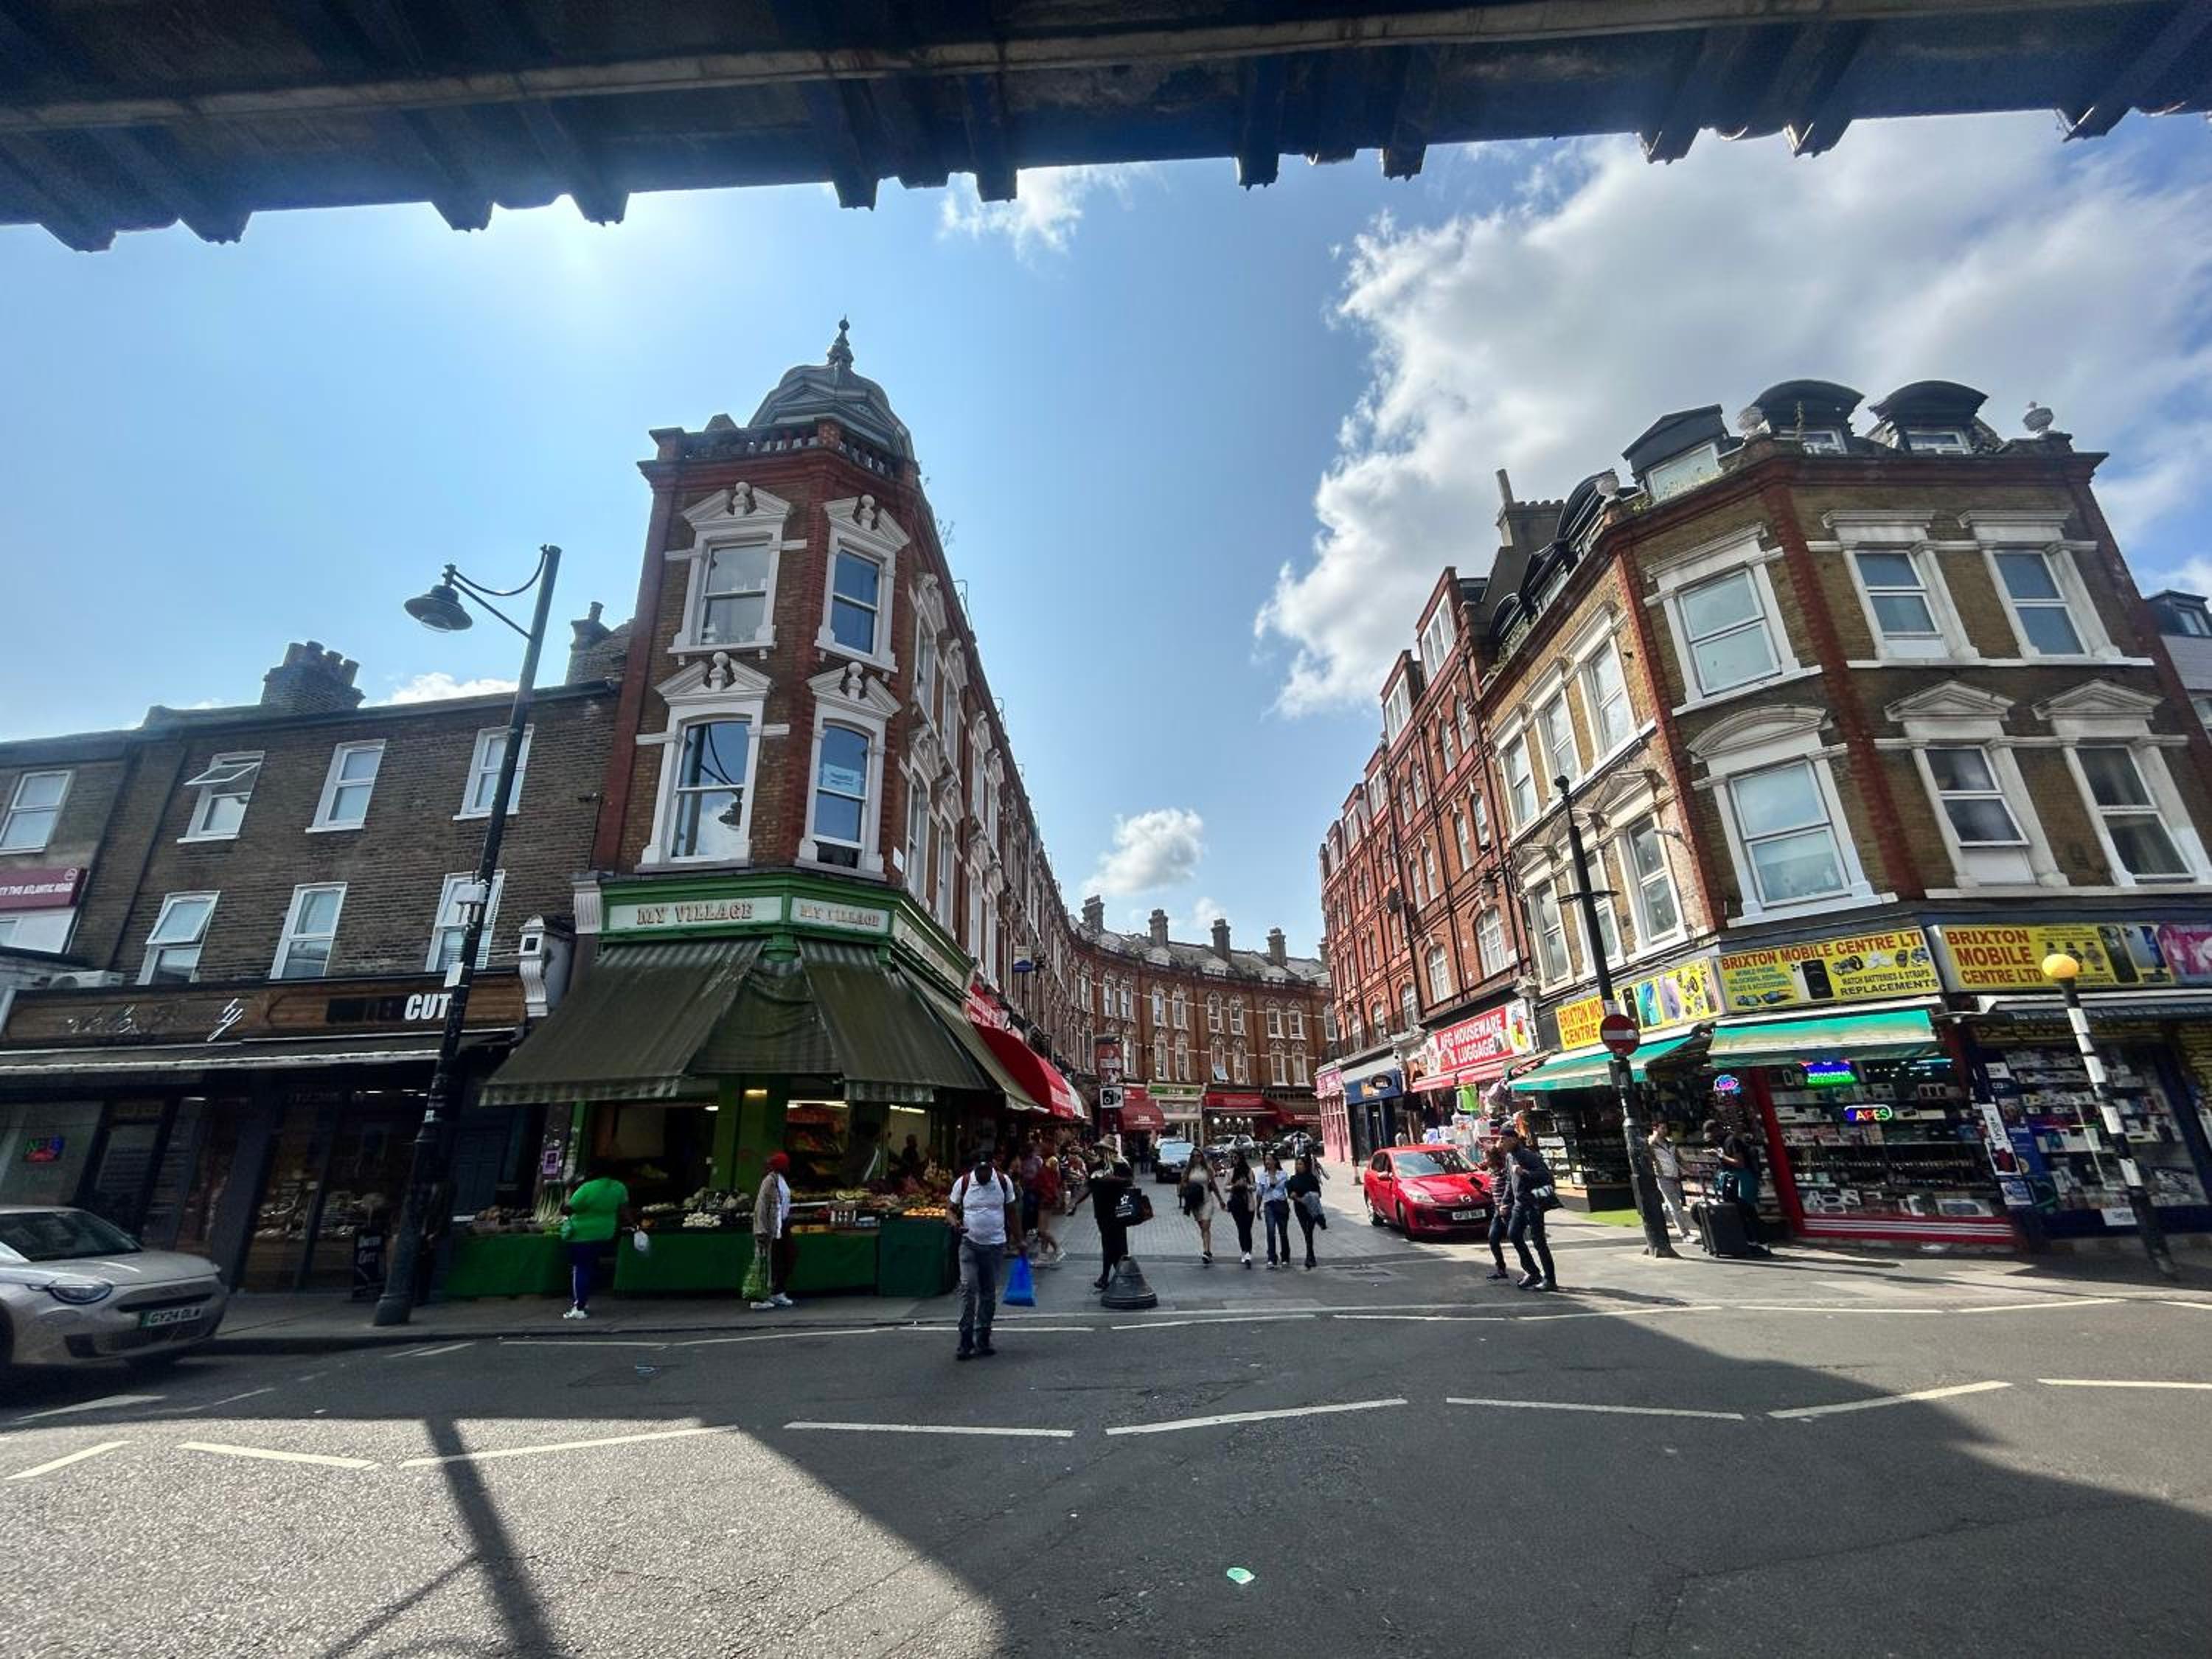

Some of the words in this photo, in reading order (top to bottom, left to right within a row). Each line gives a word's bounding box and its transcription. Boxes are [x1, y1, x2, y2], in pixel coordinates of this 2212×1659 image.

[24, 884, 55, 894] ATLANTIC
[636, 908, 668, 925] MY
[675, 902, 754, 922] VILLAGE
[827, 908, 880, 927] VILLAGE
[1945, 930, 2030, 945] BRIXTON
[1722, 951, 1775, 970] BRIXTON
[1780, 943, 1833, 961] MOBILE
[1837, 936, 1896, 955] CENTRE
[1955, 946, 2036, 967] MOBILE
[1840, 978, 1939, 995] REPLACEMENTS
[1961, 969, 2016, 984] CENTRE
[2017, 968, 2043, 983] LTD
[1559, 1001, 1587, 1028] BRIXTON
[1455, 1014, 1502, 1041] HOUSEWARE
[1563, 1023, 1599, 1045] CENTRE
[1458, 1038, 1497, 1063] LUGGAGE
